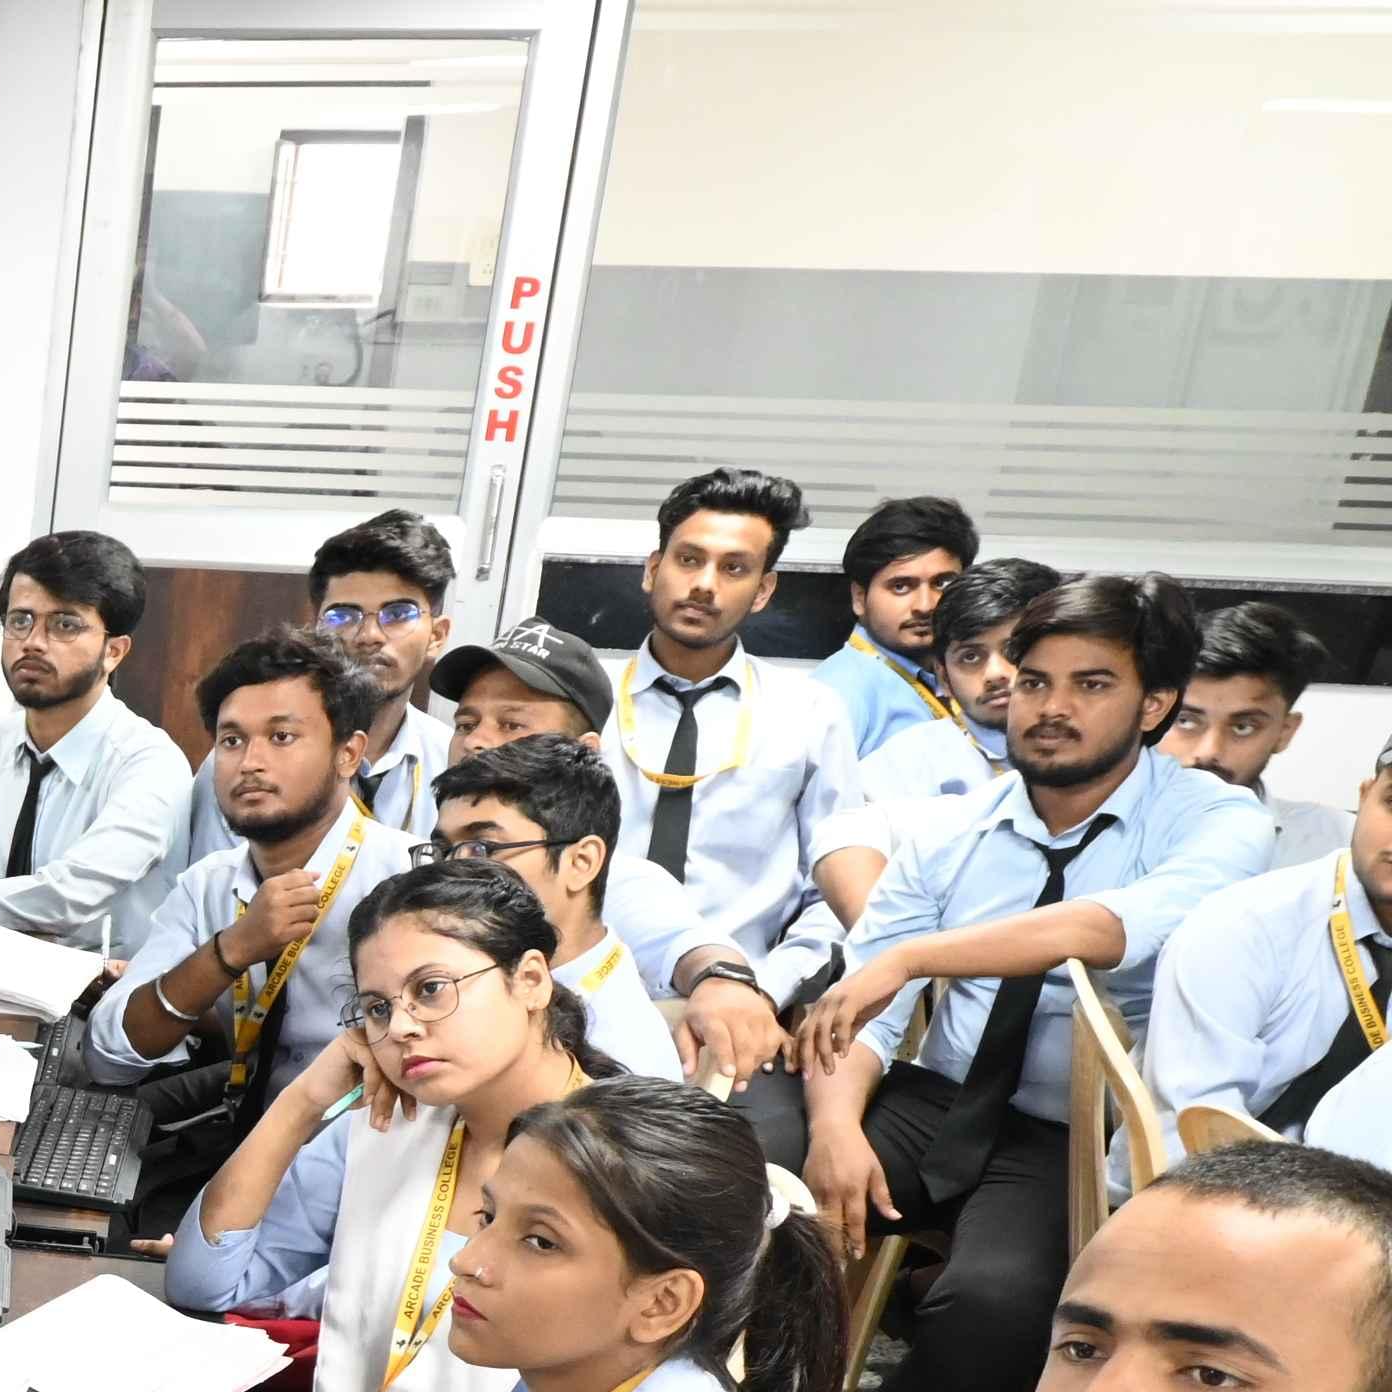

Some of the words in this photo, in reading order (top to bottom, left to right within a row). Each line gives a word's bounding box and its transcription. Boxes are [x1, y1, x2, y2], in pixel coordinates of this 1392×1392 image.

[485, 276, 541, 442] PUSH
[510, 641, 551, 660] STAR
[317, 863, 347, 909] COLLEGE
[1335, 924, 1357, 975] COLLEGE
[265, 957, 292, 998] ARCADE
[403, 1268, 427, 1320] ARCADE
[418, 1204, 446, 1265] BUSINESS
[436, 1142, 459, 1202] COLLEGE
